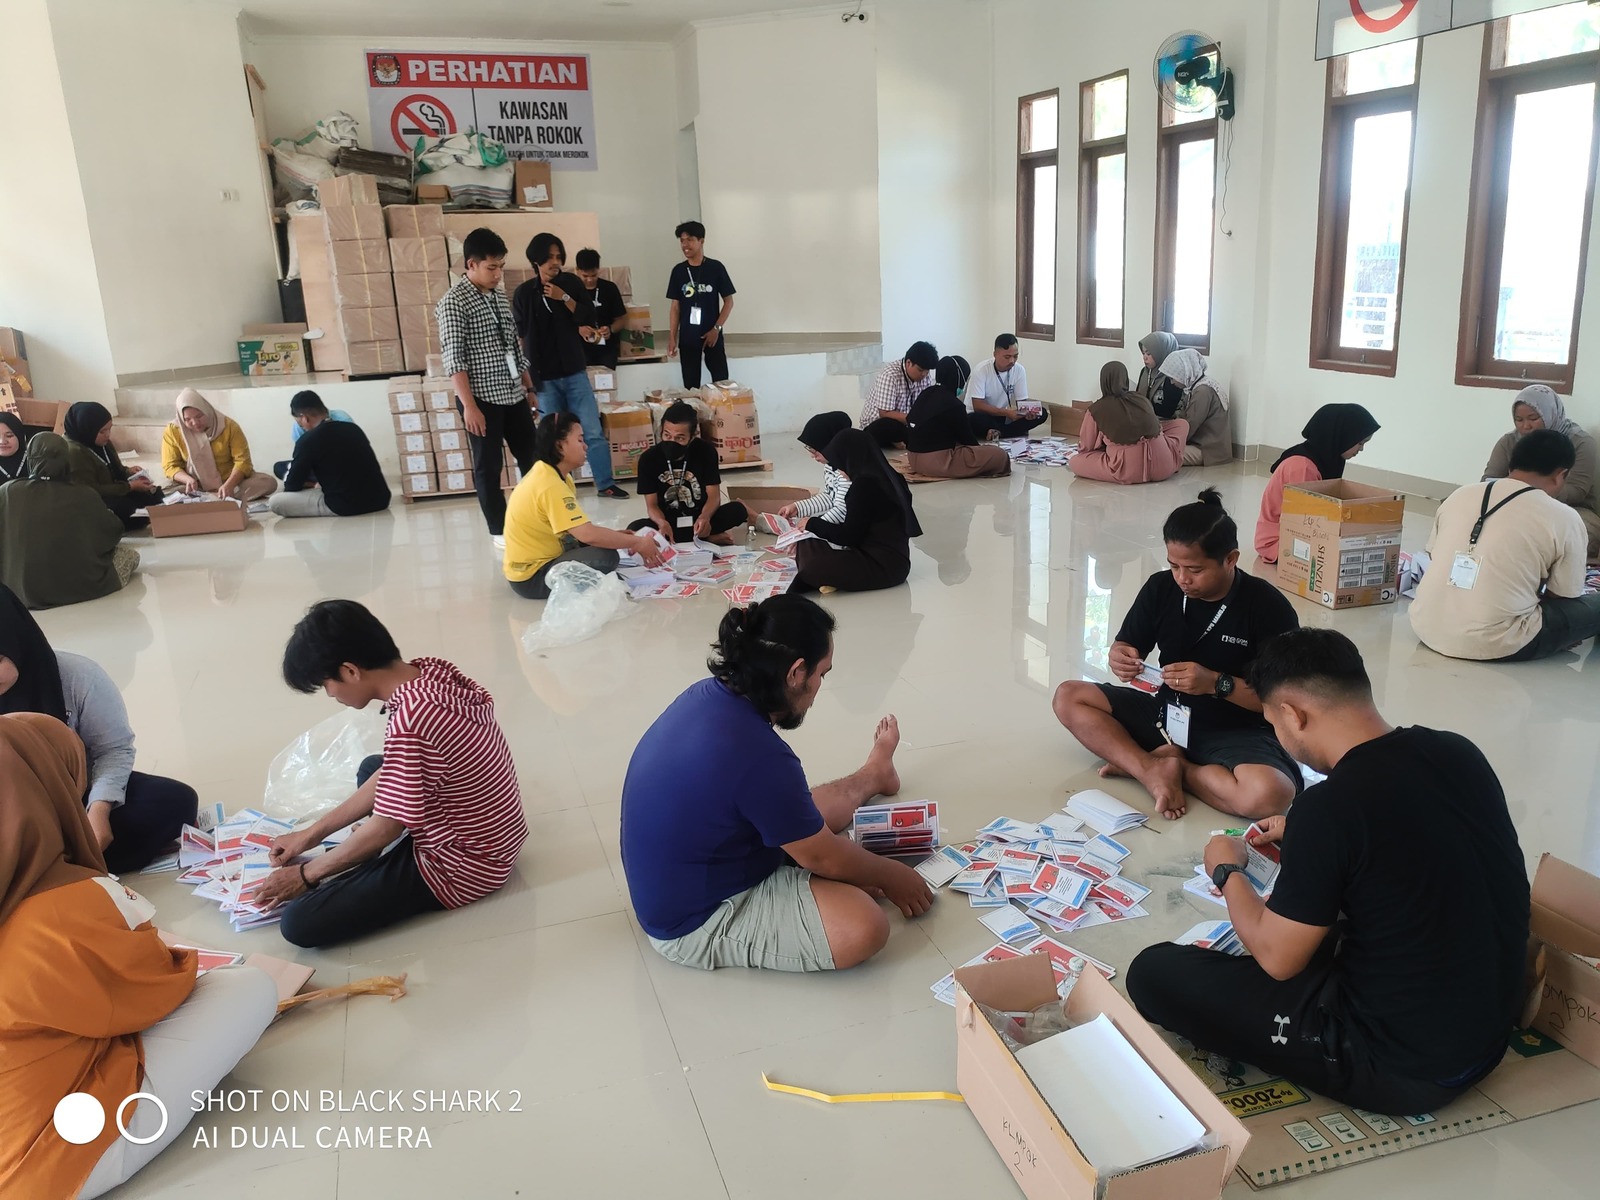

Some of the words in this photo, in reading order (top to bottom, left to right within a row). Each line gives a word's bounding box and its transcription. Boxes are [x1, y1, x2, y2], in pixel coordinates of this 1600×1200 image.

[407, 60, 578, 84] PERHATIAN
[499, 101, 568, 120] KAWASAN
[487, 125, 534, 144] TANPA
[537, 126, 584, 145] ROKOK
[1013, 1151, 1024, 1177] 2
